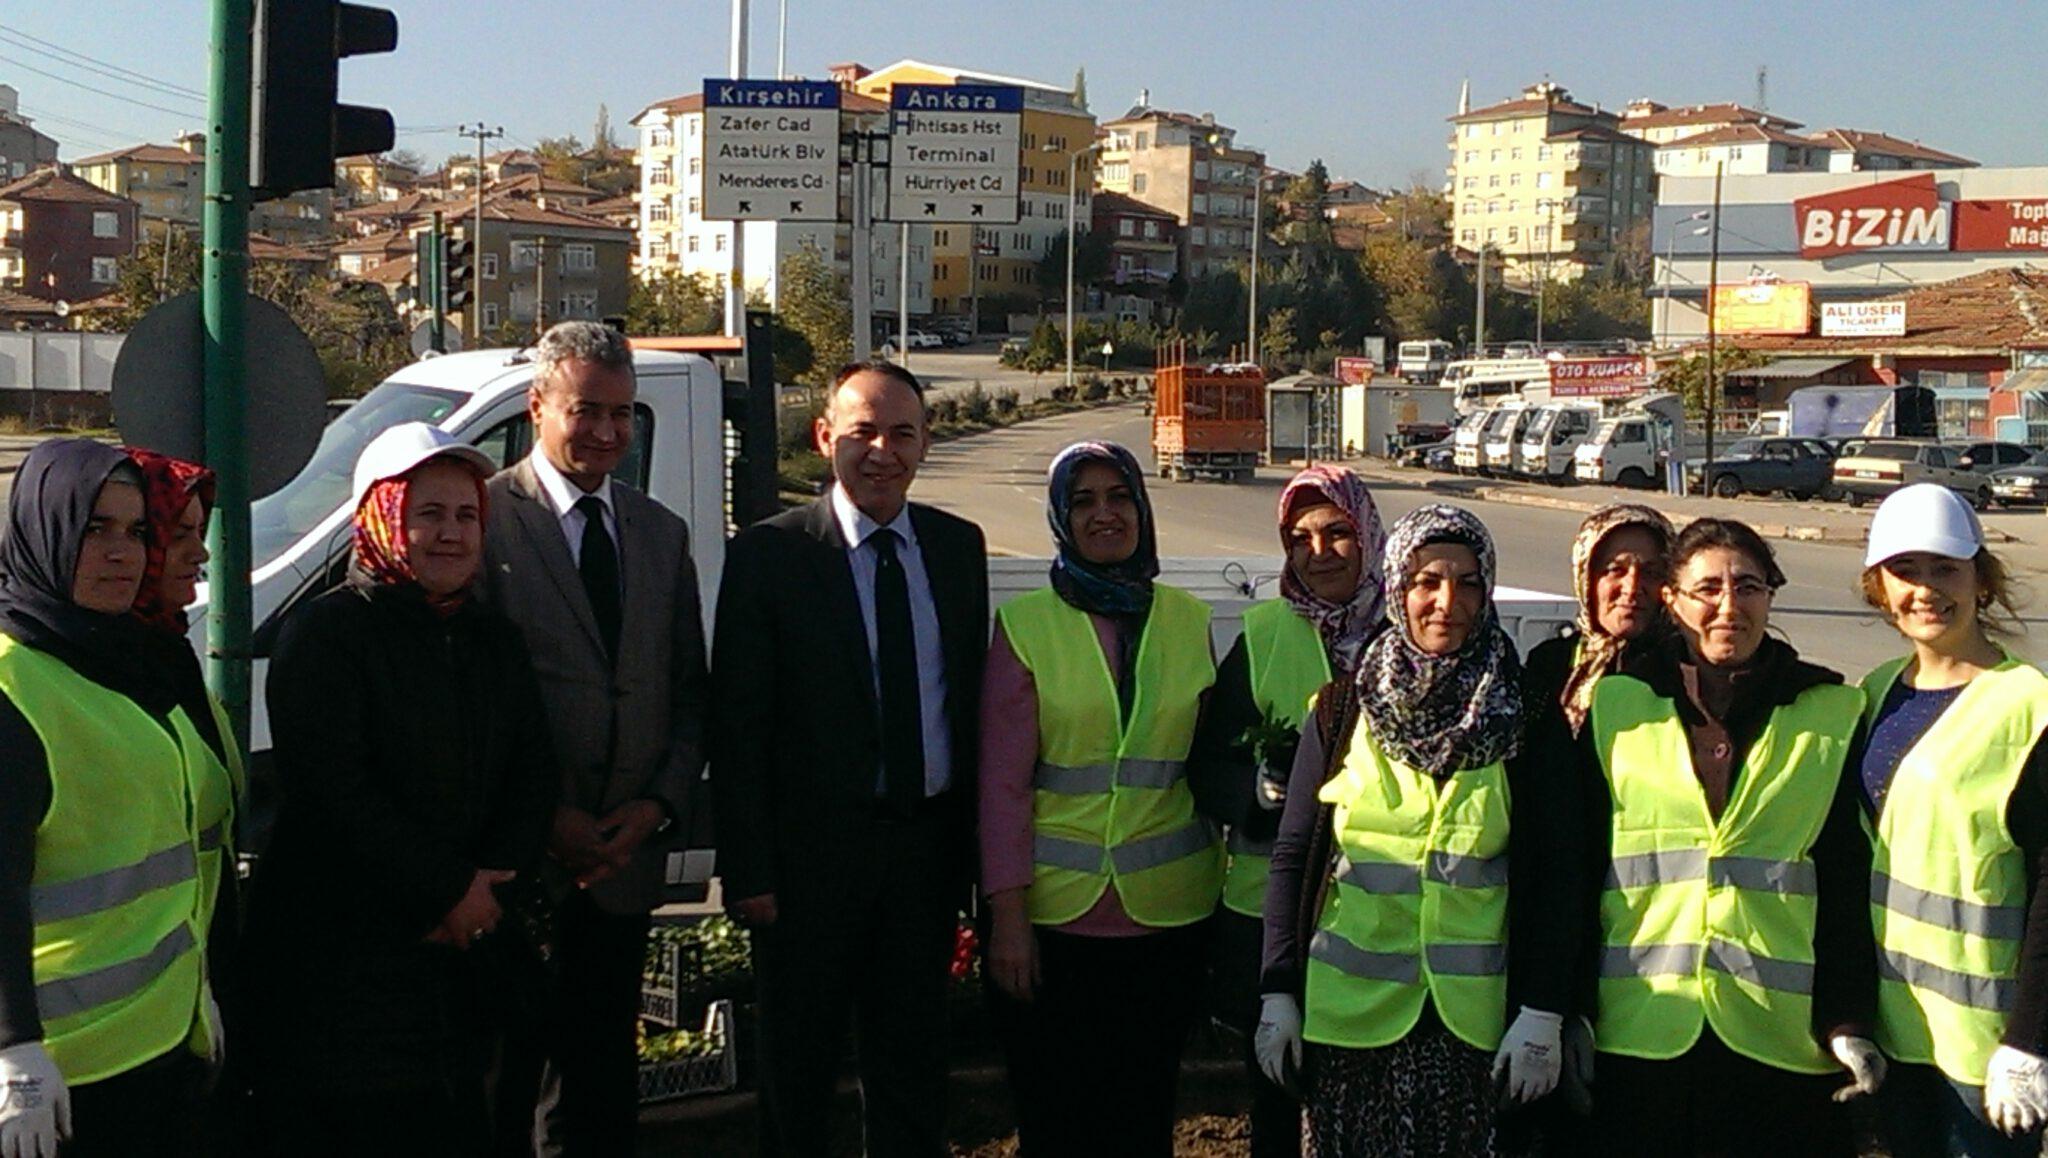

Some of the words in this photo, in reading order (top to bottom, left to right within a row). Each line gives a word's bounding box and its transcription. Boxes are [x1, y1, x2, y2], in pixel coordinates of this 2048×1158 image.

[720, 86, 823, 105] Kırşehir
[907, 90, 997, 109] Ankara
[720, 116, 771, 131] Zafer
[777, 117, 811, 132] Cad
[973, 120, 1002, 135] Hst
[719, 143, 790, 159] Atatürk
[796, 144, 825, 159] Blv
[907, 146, 995, 162] Terminal
[719, 173, 799, 188] Menderes
[905, 175, 976, 193] Hürriyet
[981, 175, 1002, 190] Cd
[1556, 363, 1583, 377] OTO
